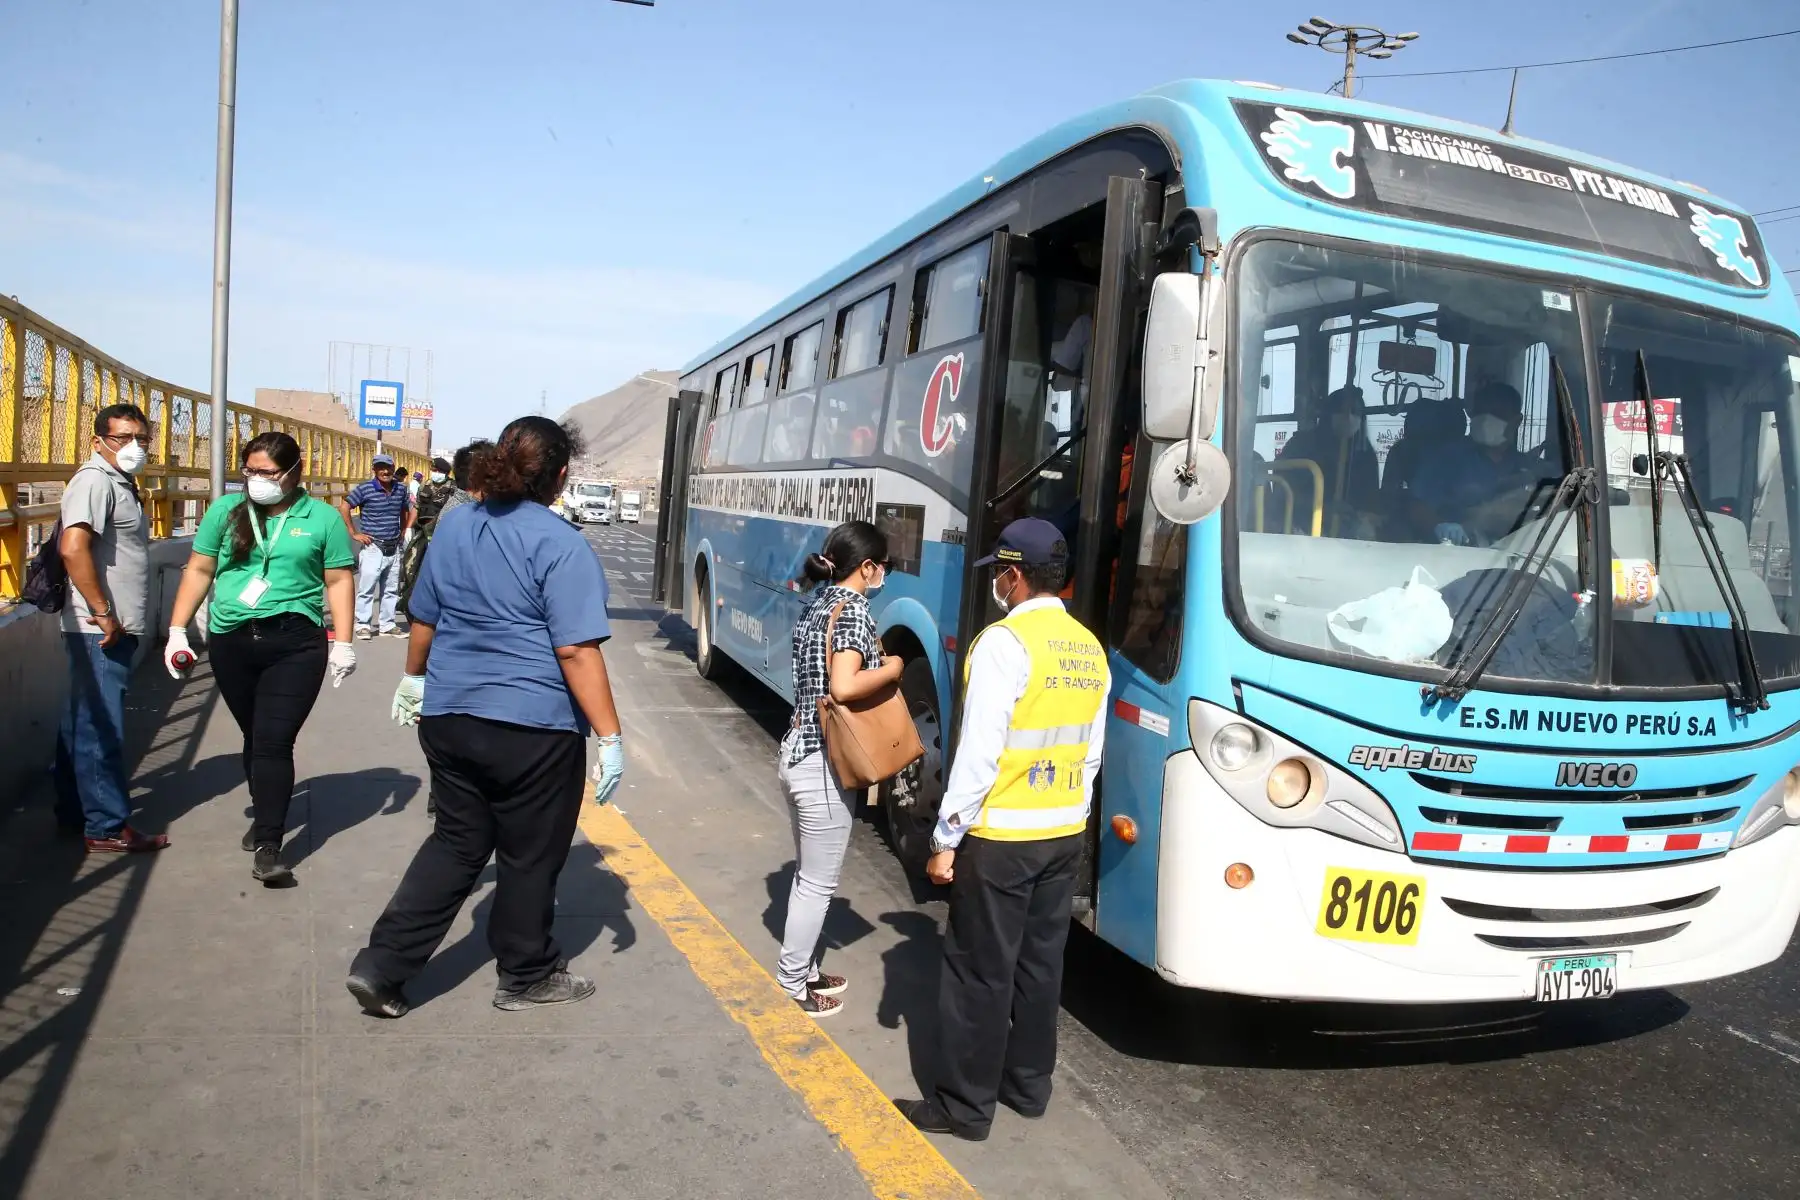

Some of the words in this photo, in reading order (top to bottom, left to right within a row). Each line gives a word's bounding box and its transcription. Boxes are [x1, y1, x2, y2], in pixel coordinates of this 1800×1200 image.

[1393, 126, 1492, 154] PACHACAMAC
[1510, 165, 1569, 189] 8106
[1568, 166, 1680, 218] PTE.PIEDRA
[920, 352, 964, 457] C
[365, 418, 396, 427] PARADERO
[778, 478, 813, 518] ZAPALLAL
[1059, 658, 1100, 674] MUNICIPAL
[1045, 676, 1058, 689] DE
[1460, 706, 1529, 731] E.S.M
[1537, 711, 1618, 734] NUEVO
[1625, 711, 1681, 736] PERÚ
[1686, 716, 1717, 737] S.A
[1348, 744, 1425, 772] apple
[1427, 746, 1477, 773] bus
[1556, 762, 1638, 788] IVECO
[1325, 876, 1419, 936] 8106
[1564, 959, 1592, 970] PERU
[1542, 967, 1613, 1001] AYT-904
